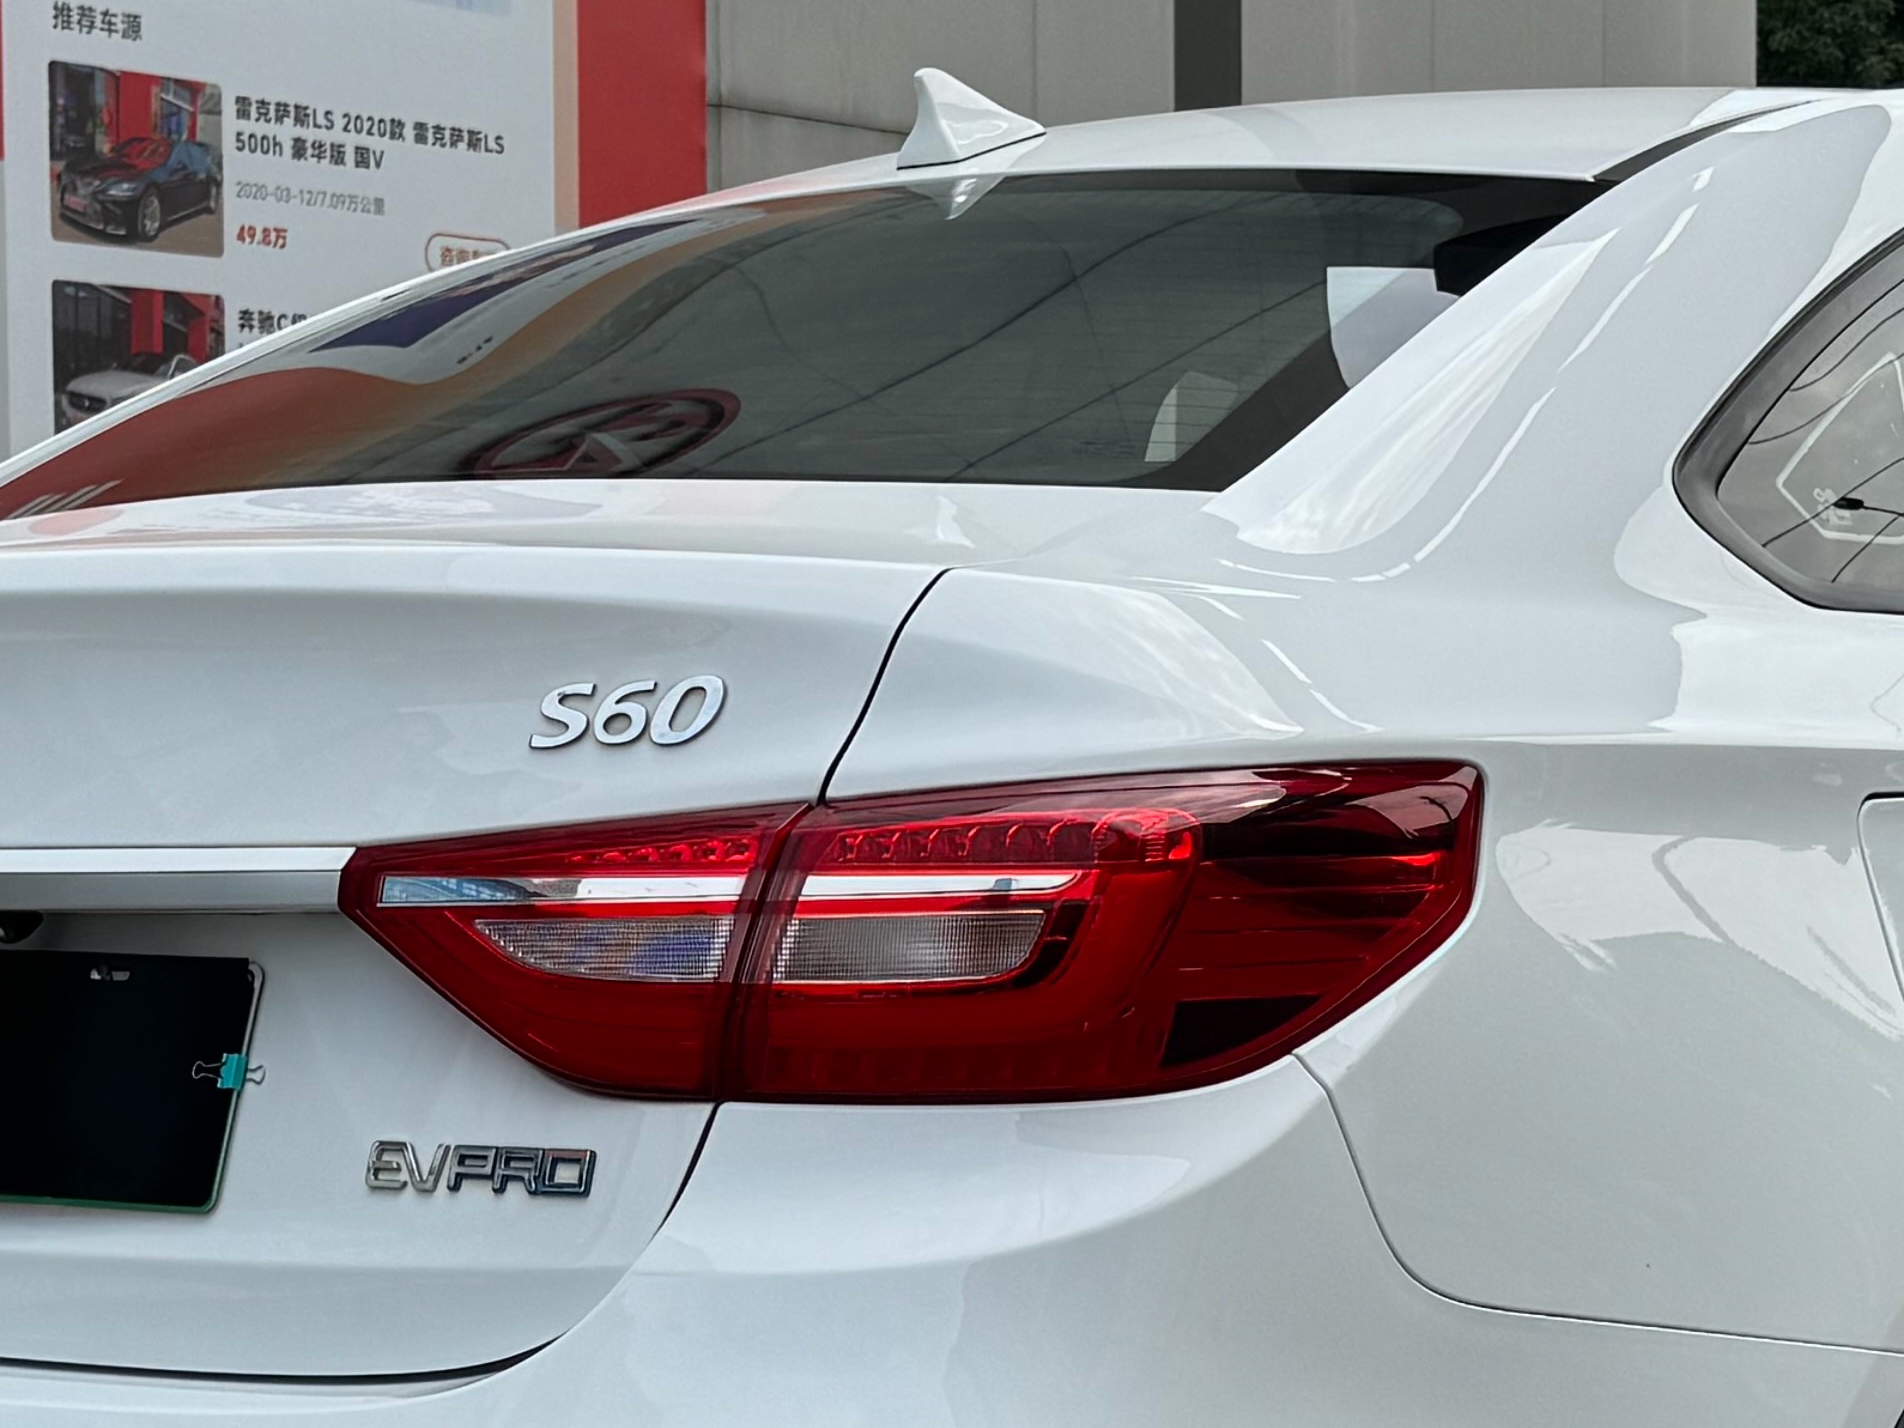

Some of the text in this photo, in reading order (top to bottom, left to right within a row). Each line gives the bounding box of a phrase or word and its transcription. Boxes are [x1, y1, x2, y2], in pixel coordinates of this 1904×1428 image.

[51, 0, 144, 43] 推荐车源
[234, 95, 506, 156] 雷克萨斯LS 2020款 雷克萨斯LS
[234, 131, 284, 158] 500h
[290, 137, 347, 168] 豪华版
[236, 224, 289, 251] 49.8万
[529, 674, 726, 751] S60
